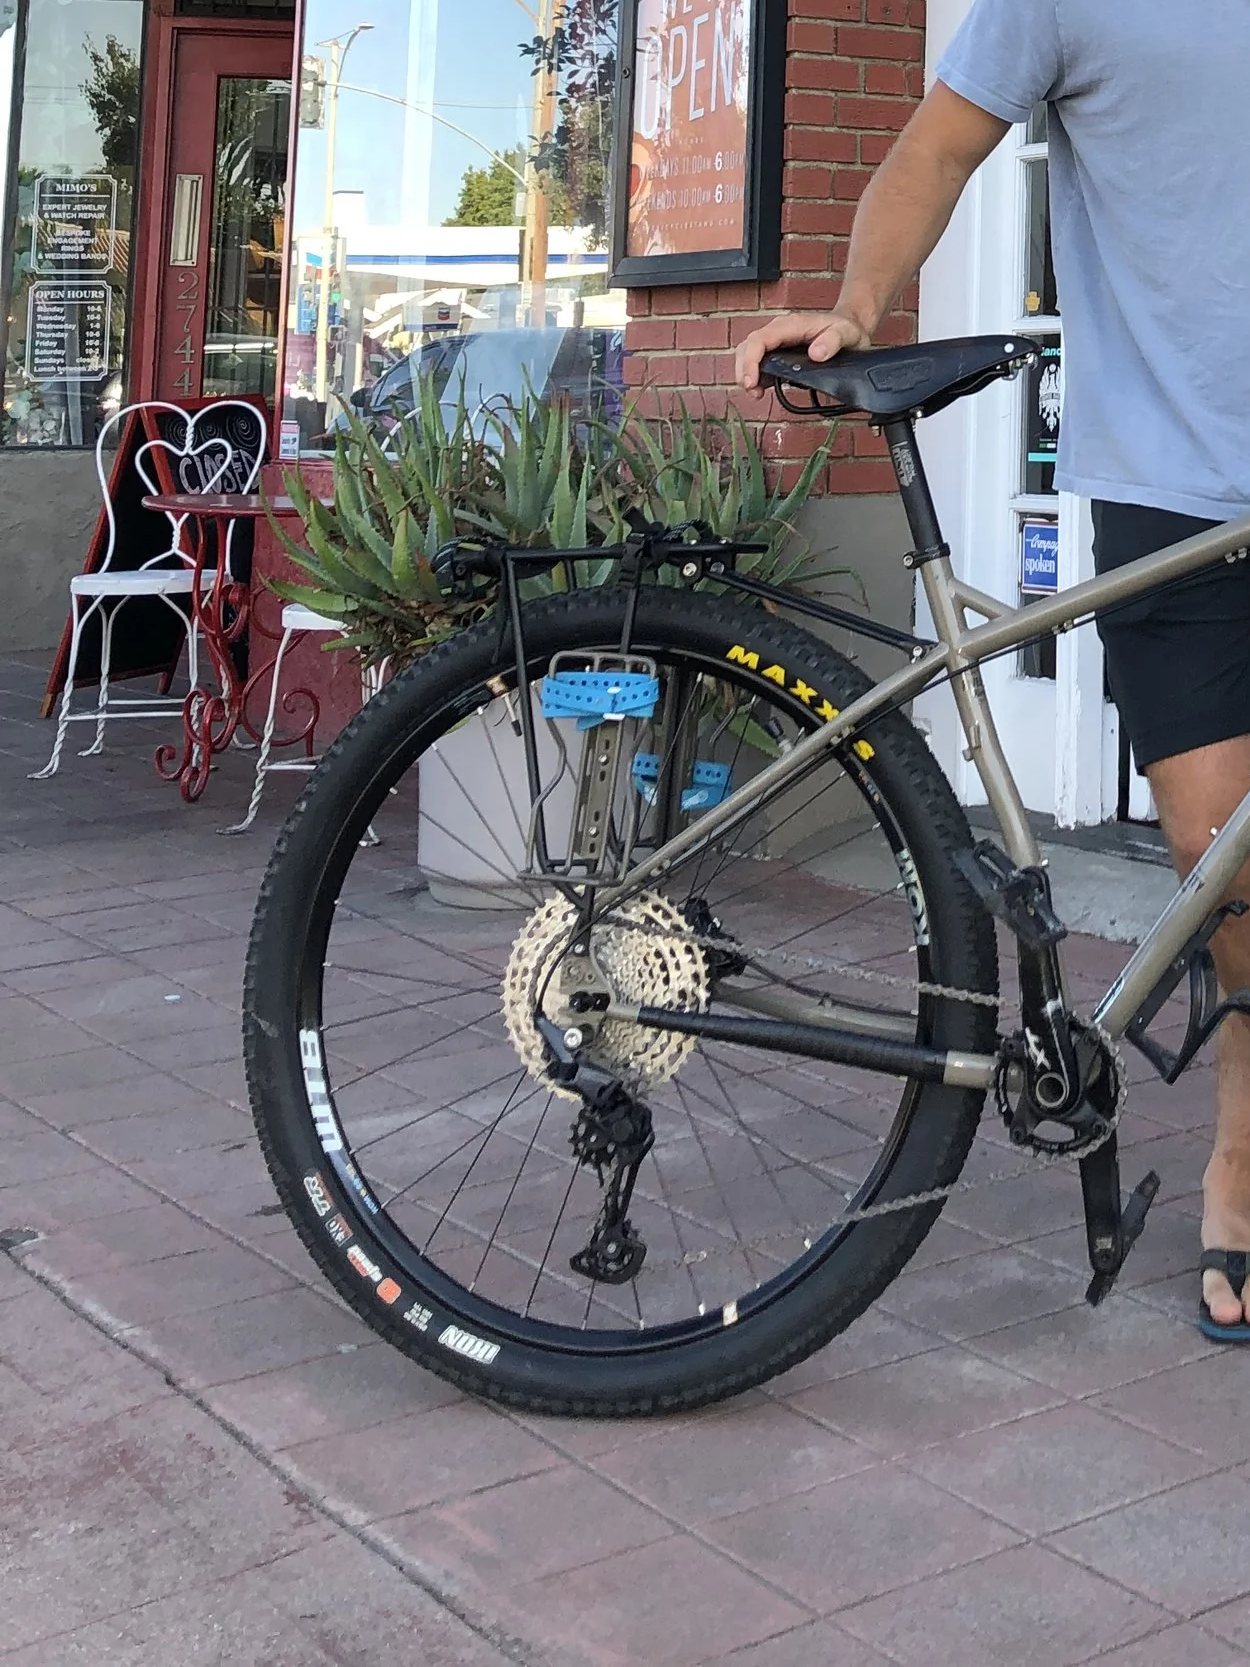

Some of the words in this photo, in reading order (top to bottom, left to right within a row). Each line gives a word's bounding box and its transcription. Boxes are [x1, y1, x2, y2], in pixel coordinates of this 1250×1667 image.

[641, 0, 738, 140] OPEN
[56, 184, 97, 193] MIMO'S
[35, 290, 65, 299] OPEN
[67, 290, 105, 299] HOURS
[1025, 553, 1055, 575] spoken
[725, 645, 875, 761] MAXXS
[299, 1029, 343, 1153] WTB
[438, 1325, 501, 1365] IKON
